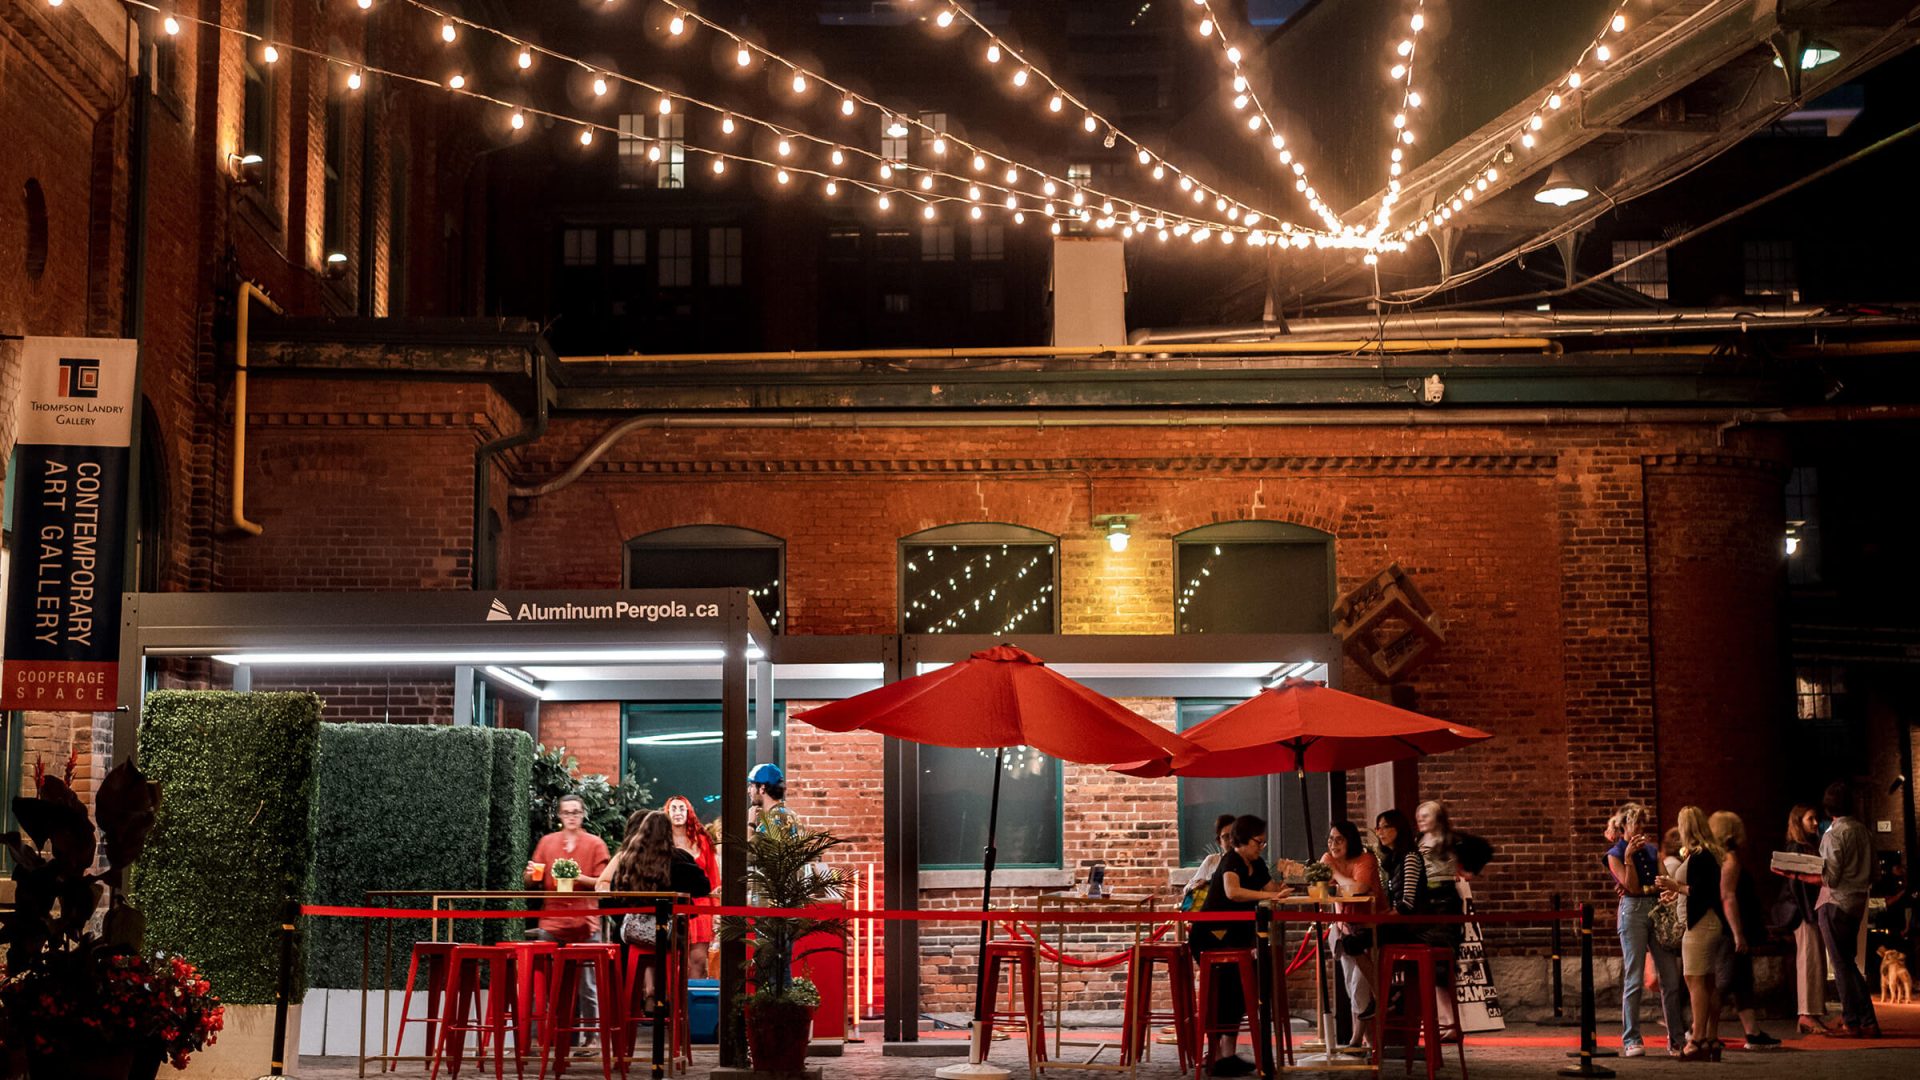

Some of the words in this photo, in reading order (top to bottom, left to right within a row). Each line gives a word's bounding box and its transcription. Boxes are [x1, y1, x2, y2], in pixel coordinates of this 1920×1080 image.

[30, 401, 84, 413] THOMPSON
[87, 403, 125, 414] LANDRY
[55, 414, 96, 426] GALLERY
[43, 460, 68, 511] ART
[67, 462, 101, 646] CONTEMPORARY
[35, 525, 64, 645] GALLERY
[17, 670, 105, 684] COOPERAGE
[16, 687, 104, 700] SPACE
